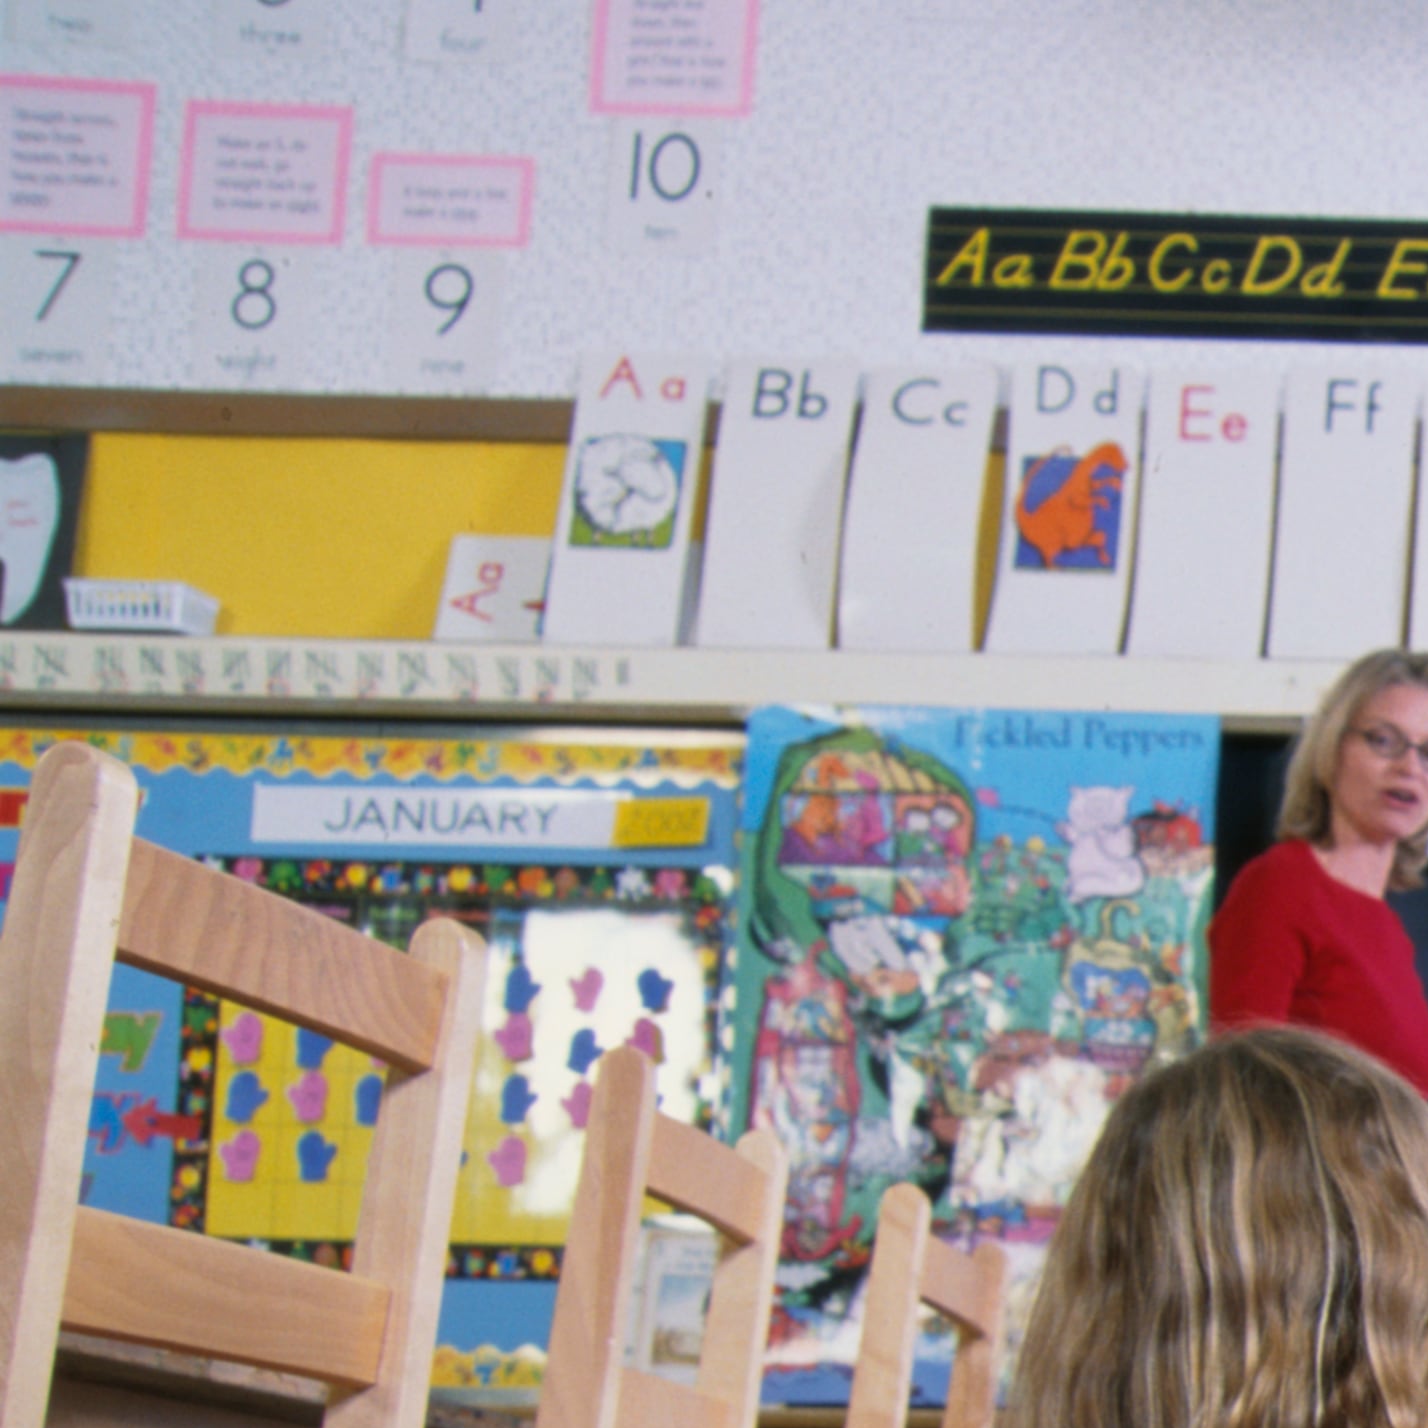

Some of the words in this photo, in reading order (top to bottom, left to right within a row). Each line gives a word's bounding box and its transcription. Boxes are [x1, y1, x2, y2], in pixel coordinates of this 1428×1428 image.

[629, 129, 702, 202] 10
[33, 248, 84, 323] 7
[937, 227, 1033, 288] Aa
[1048, 230, 1136, 294] Bb
[1148, 232, 1231, 293] Cc
[1240, 235, 1351, 297] Dd
[230, 257, 278, 331] 8
[423, 261, 476, 337] 9
[18, 345, 84, 364] seven
[216, 347, 278, 378] eight
[599, 356, 687, 401] Aa
[751, 367, 828, 420] Bb
[890, 377, 968, 427] Cc
[1035, 364, 1119, 415] Dd
[1178, 385, 1249, 443] Ee
[1325, 378, 1383, 435] Ff
[323, 797, 560, 833] JANUARY
